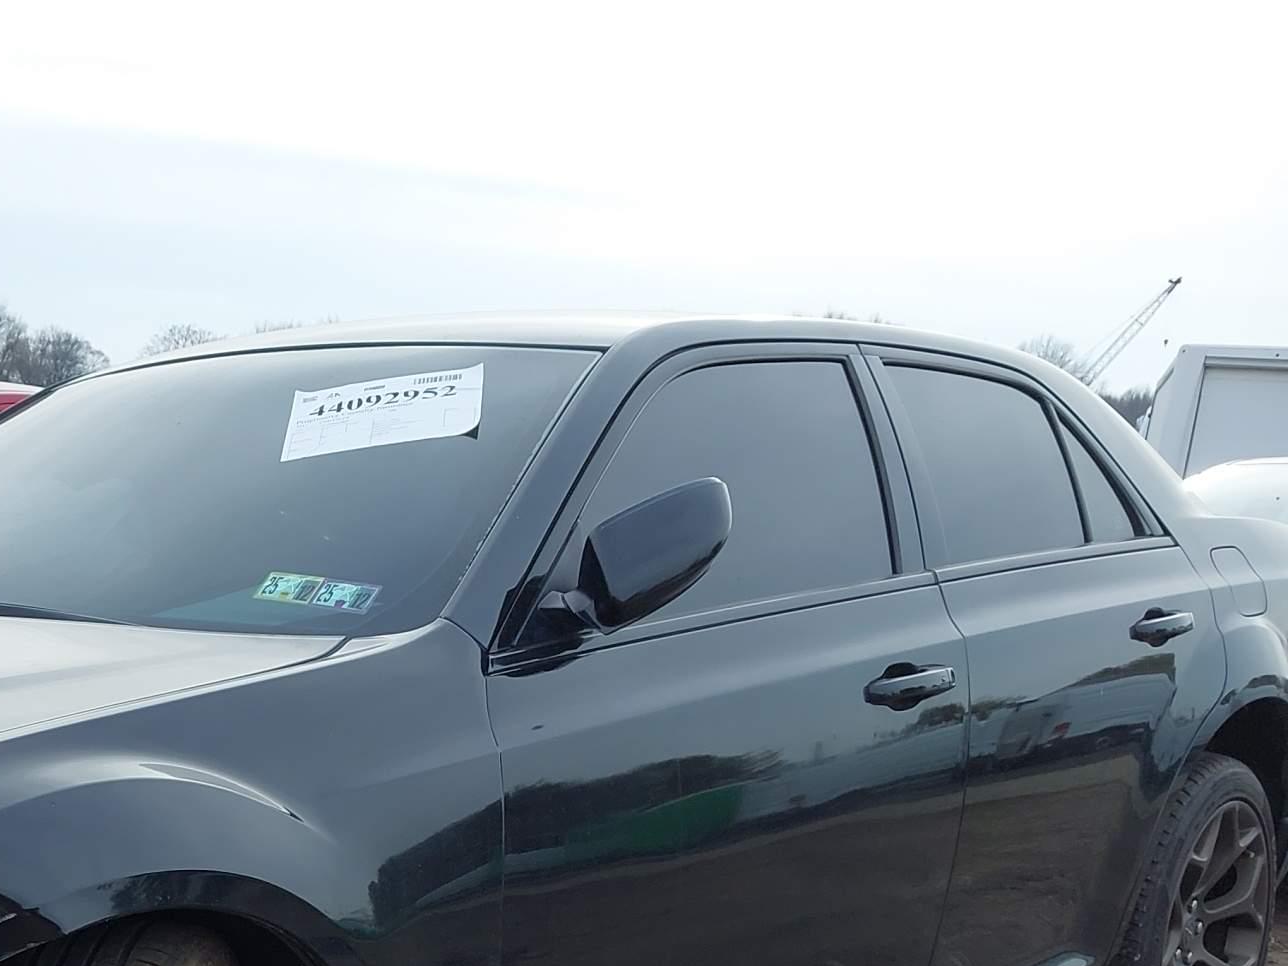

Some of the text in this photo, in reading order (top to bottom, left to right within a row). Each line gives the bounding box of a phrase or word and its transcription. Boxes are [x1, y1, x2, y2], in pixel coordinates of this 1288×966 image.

[309, 385, 457, 416] 44092952
[262, 576, 284, 595] 25
[317, 584, 339, 603] 25
